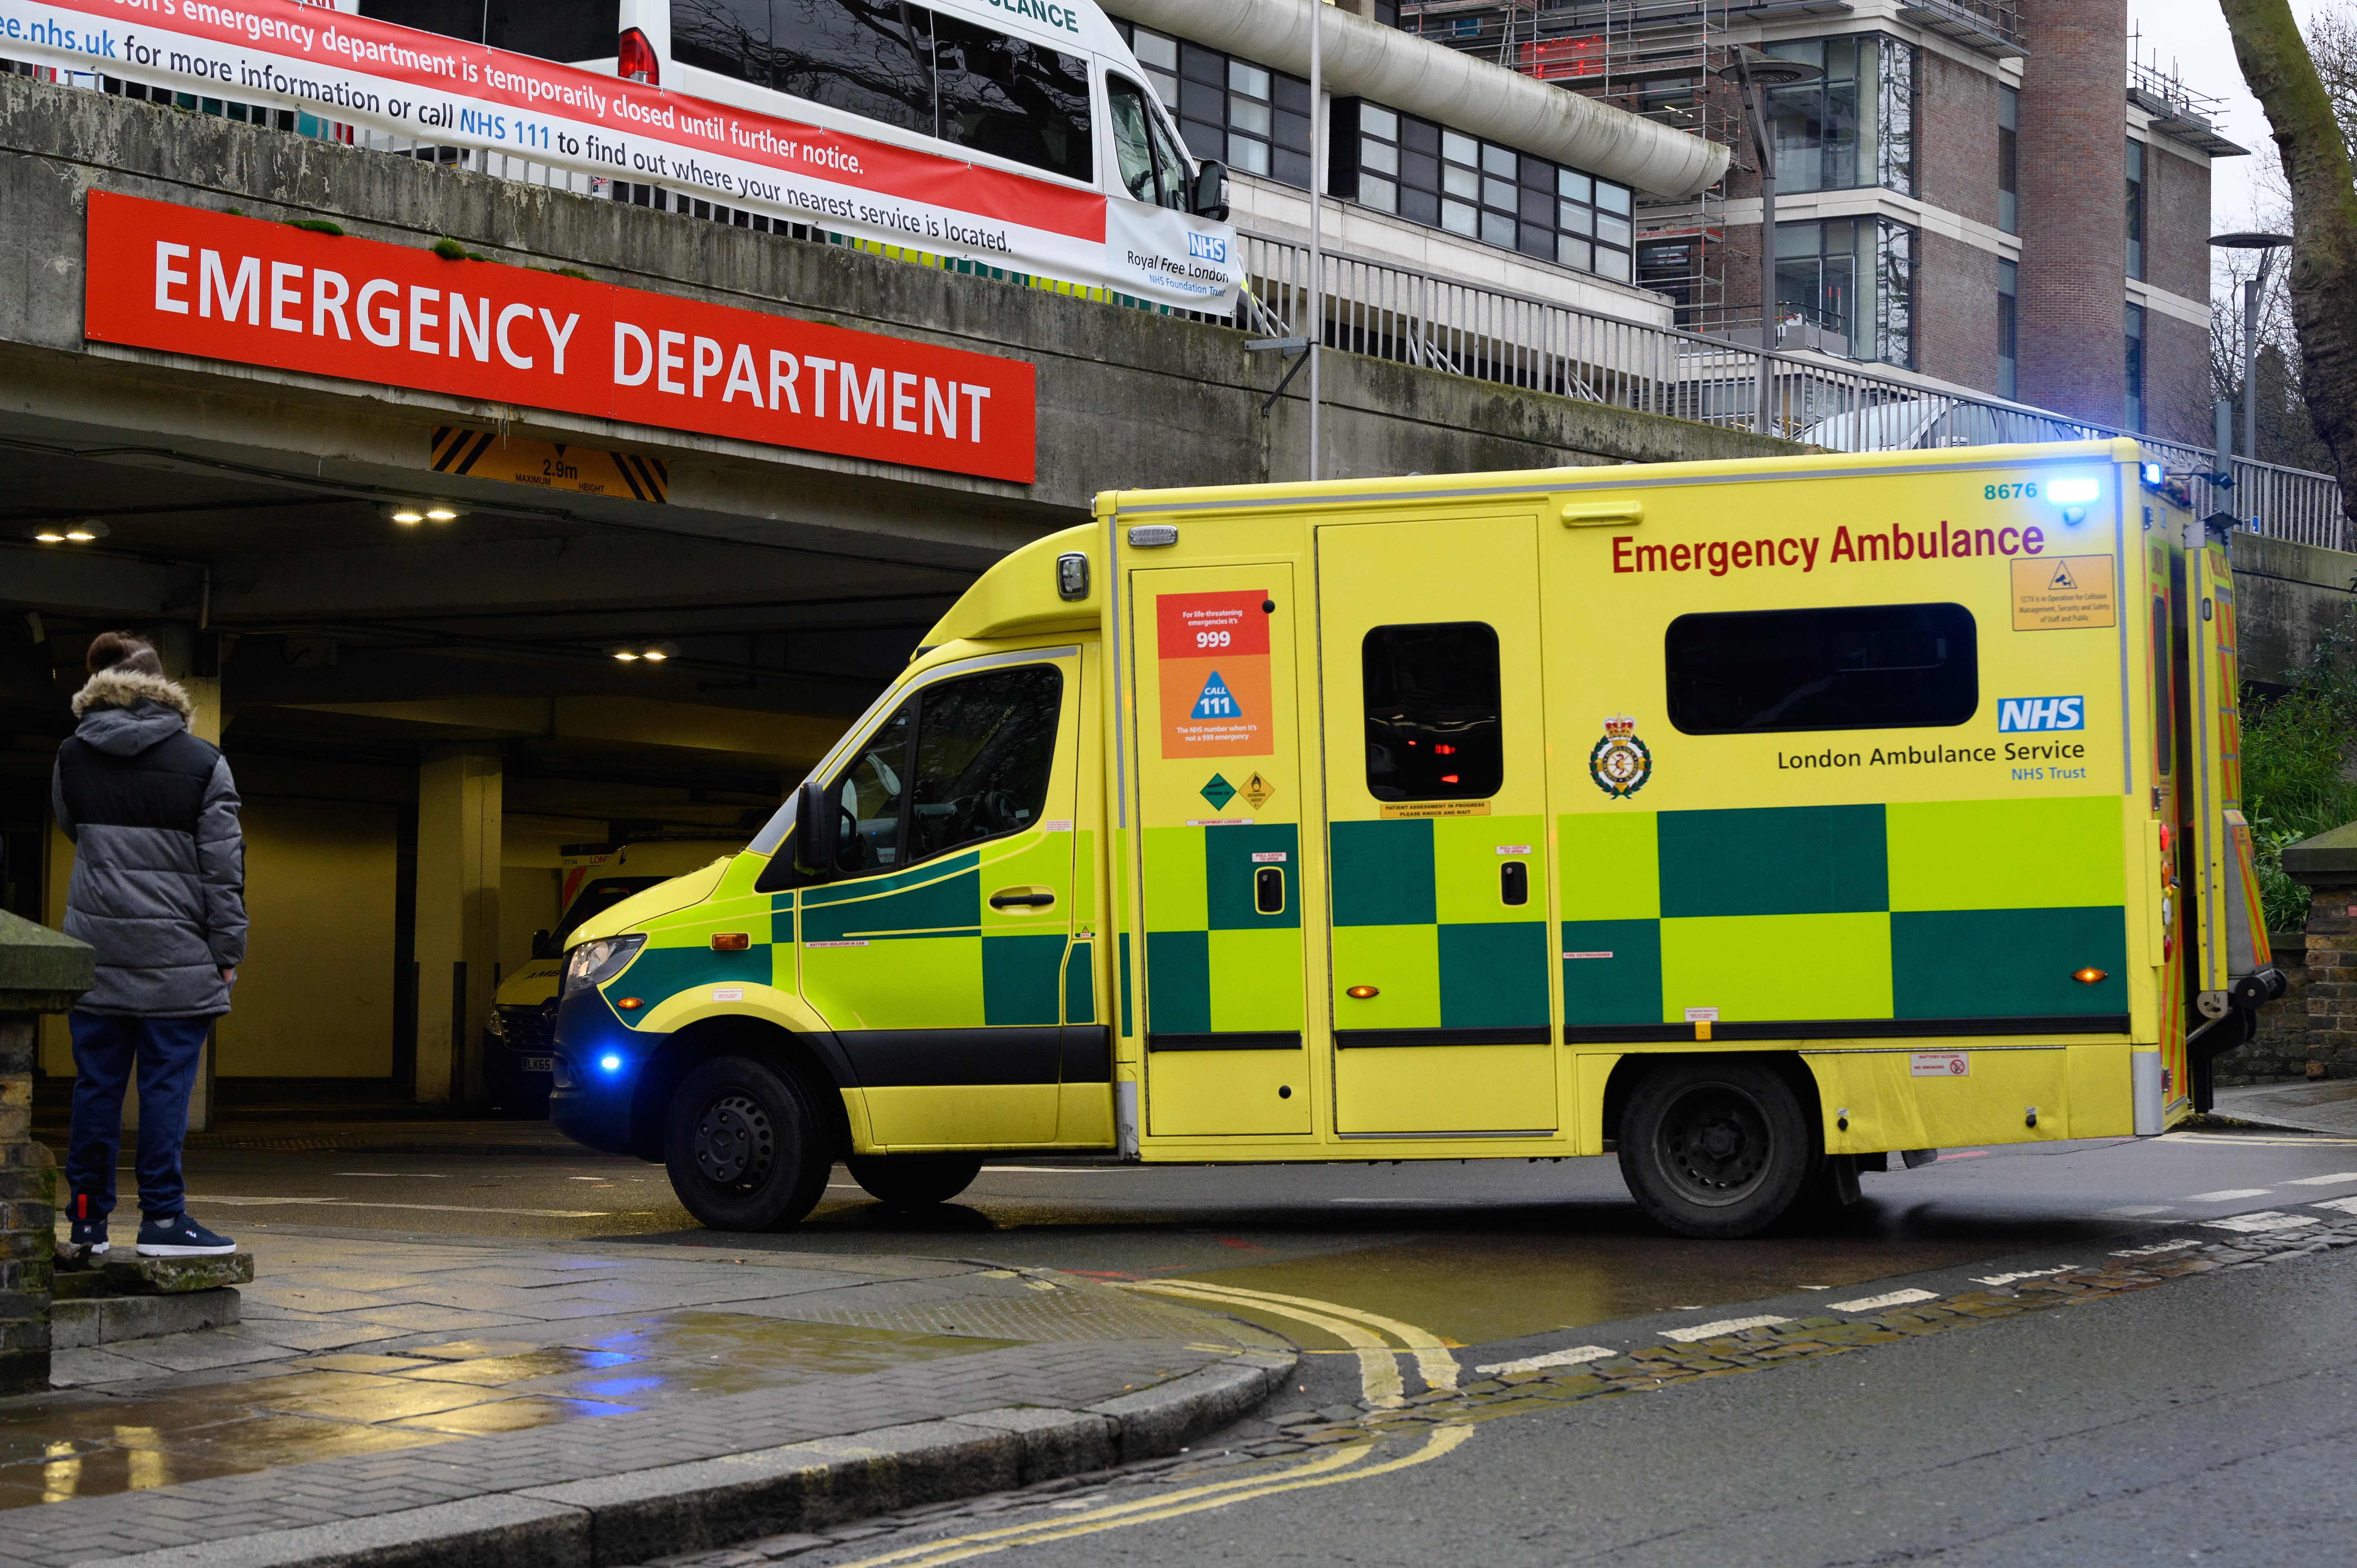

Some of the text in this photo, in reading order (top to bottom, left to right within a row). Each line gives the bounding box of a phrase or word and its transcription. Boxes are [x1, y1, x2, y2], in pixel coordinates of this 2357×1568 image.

[988, 0, 1079, 33] LANCE
[184, 1, 315, 51] emergency
[322, 26, 456, 78] department
[462, 56, 478, 82] is
[485, 64, 606, 118] temporarily
[613, 94, 674, 130] closed
[681, 115, 724, 141] until
[730, 121, 797, 158] further
[803, 145, 863, 174] notice.
[124, 35, 161, 66] for
[171, 52, 232, 81] more
[242, 60, 380, 112] information
[389, 99, 411, 119] or
[419, 103, 453, 128] call
[461, 108, 505, 139] NHS
[515, 121, 548, 149] 111
[558, 132, 579, 155] to
[586, 135, 626, 166] find
[634, 153, 667, 175] out
[672, 159, 732, 190] where
[738, 177, 780, 202] your
[788, 189, 855, 219] nearest
[860, 206, 920, 233] service
[926, 214, 939, 237] is
[945, 217, 1011, 253] located.
[1191, 234, 1224, 261] NHS
[1128, 250, 1228, 283] Royal Free London
[1149, 274, 1226, 297] NHS Foundation Trust
[155, 240, 991, 444] EMERGENCY DEPARTMENT
[543, 459, 578, 480] 2.9m
[515, 473, 604, 493] MAXIMUM HEIGHT
[1984, 482, 2037, 500] 8676
[1612, 520, 2044, 576] Emergency Ambulance
[2048, 595, 2074, 603] Operation
[1188, 618, 1228, 626] emergencies
[1194, 609, 1243, 617] life-threatening
[1196, 631, 1230, 648] 999
[1204, 687, 1226, 695] CALL
[1200, 697, 1230, 714] 111
[1999, 697, 2082, 731] NHS
[1778, 740, 2085, 769] London Ambulance Service
[2012, 766, 2086, 780] NHS Trust
[523, 970, 560, 980] AMB
[528, 1059, 550, 1070] LK65
